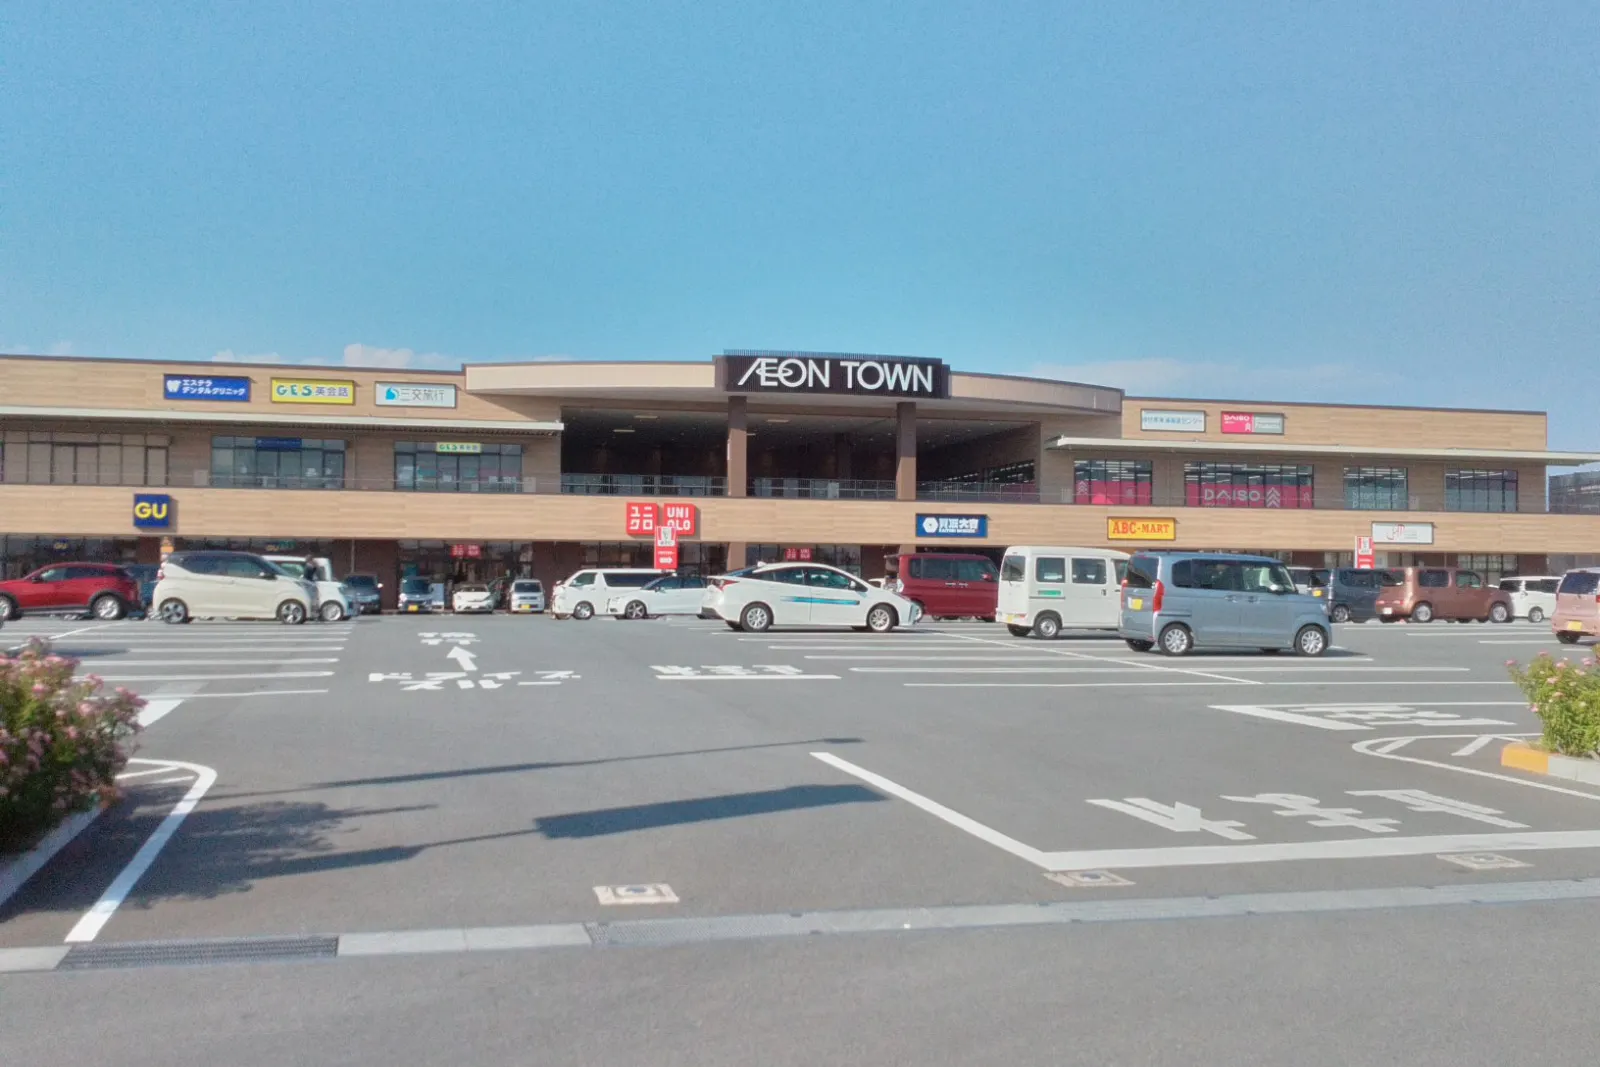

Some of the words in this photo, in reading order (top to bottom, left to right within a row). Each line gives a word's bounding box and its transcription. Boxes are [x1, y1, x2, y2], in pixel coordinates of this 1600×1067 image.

[840, 361, 932, 392] TOWN
[182, 387, 246, 396] デンタルクリニック
[276, 385, 313, 397] GES
[315, 386, 349, 397] 英会話
[1223, 413, 1250, 422] DAISO
[1204, 487, 1261, 502] DAISO
[134, 502, 168, 519] GU
[629, 505, 653, 518] ユニ
[666, 506, 690, 518] UNI
[629, 518, 653, 530] クロ
[1112, 519, 1170, 535] ABC-MART
